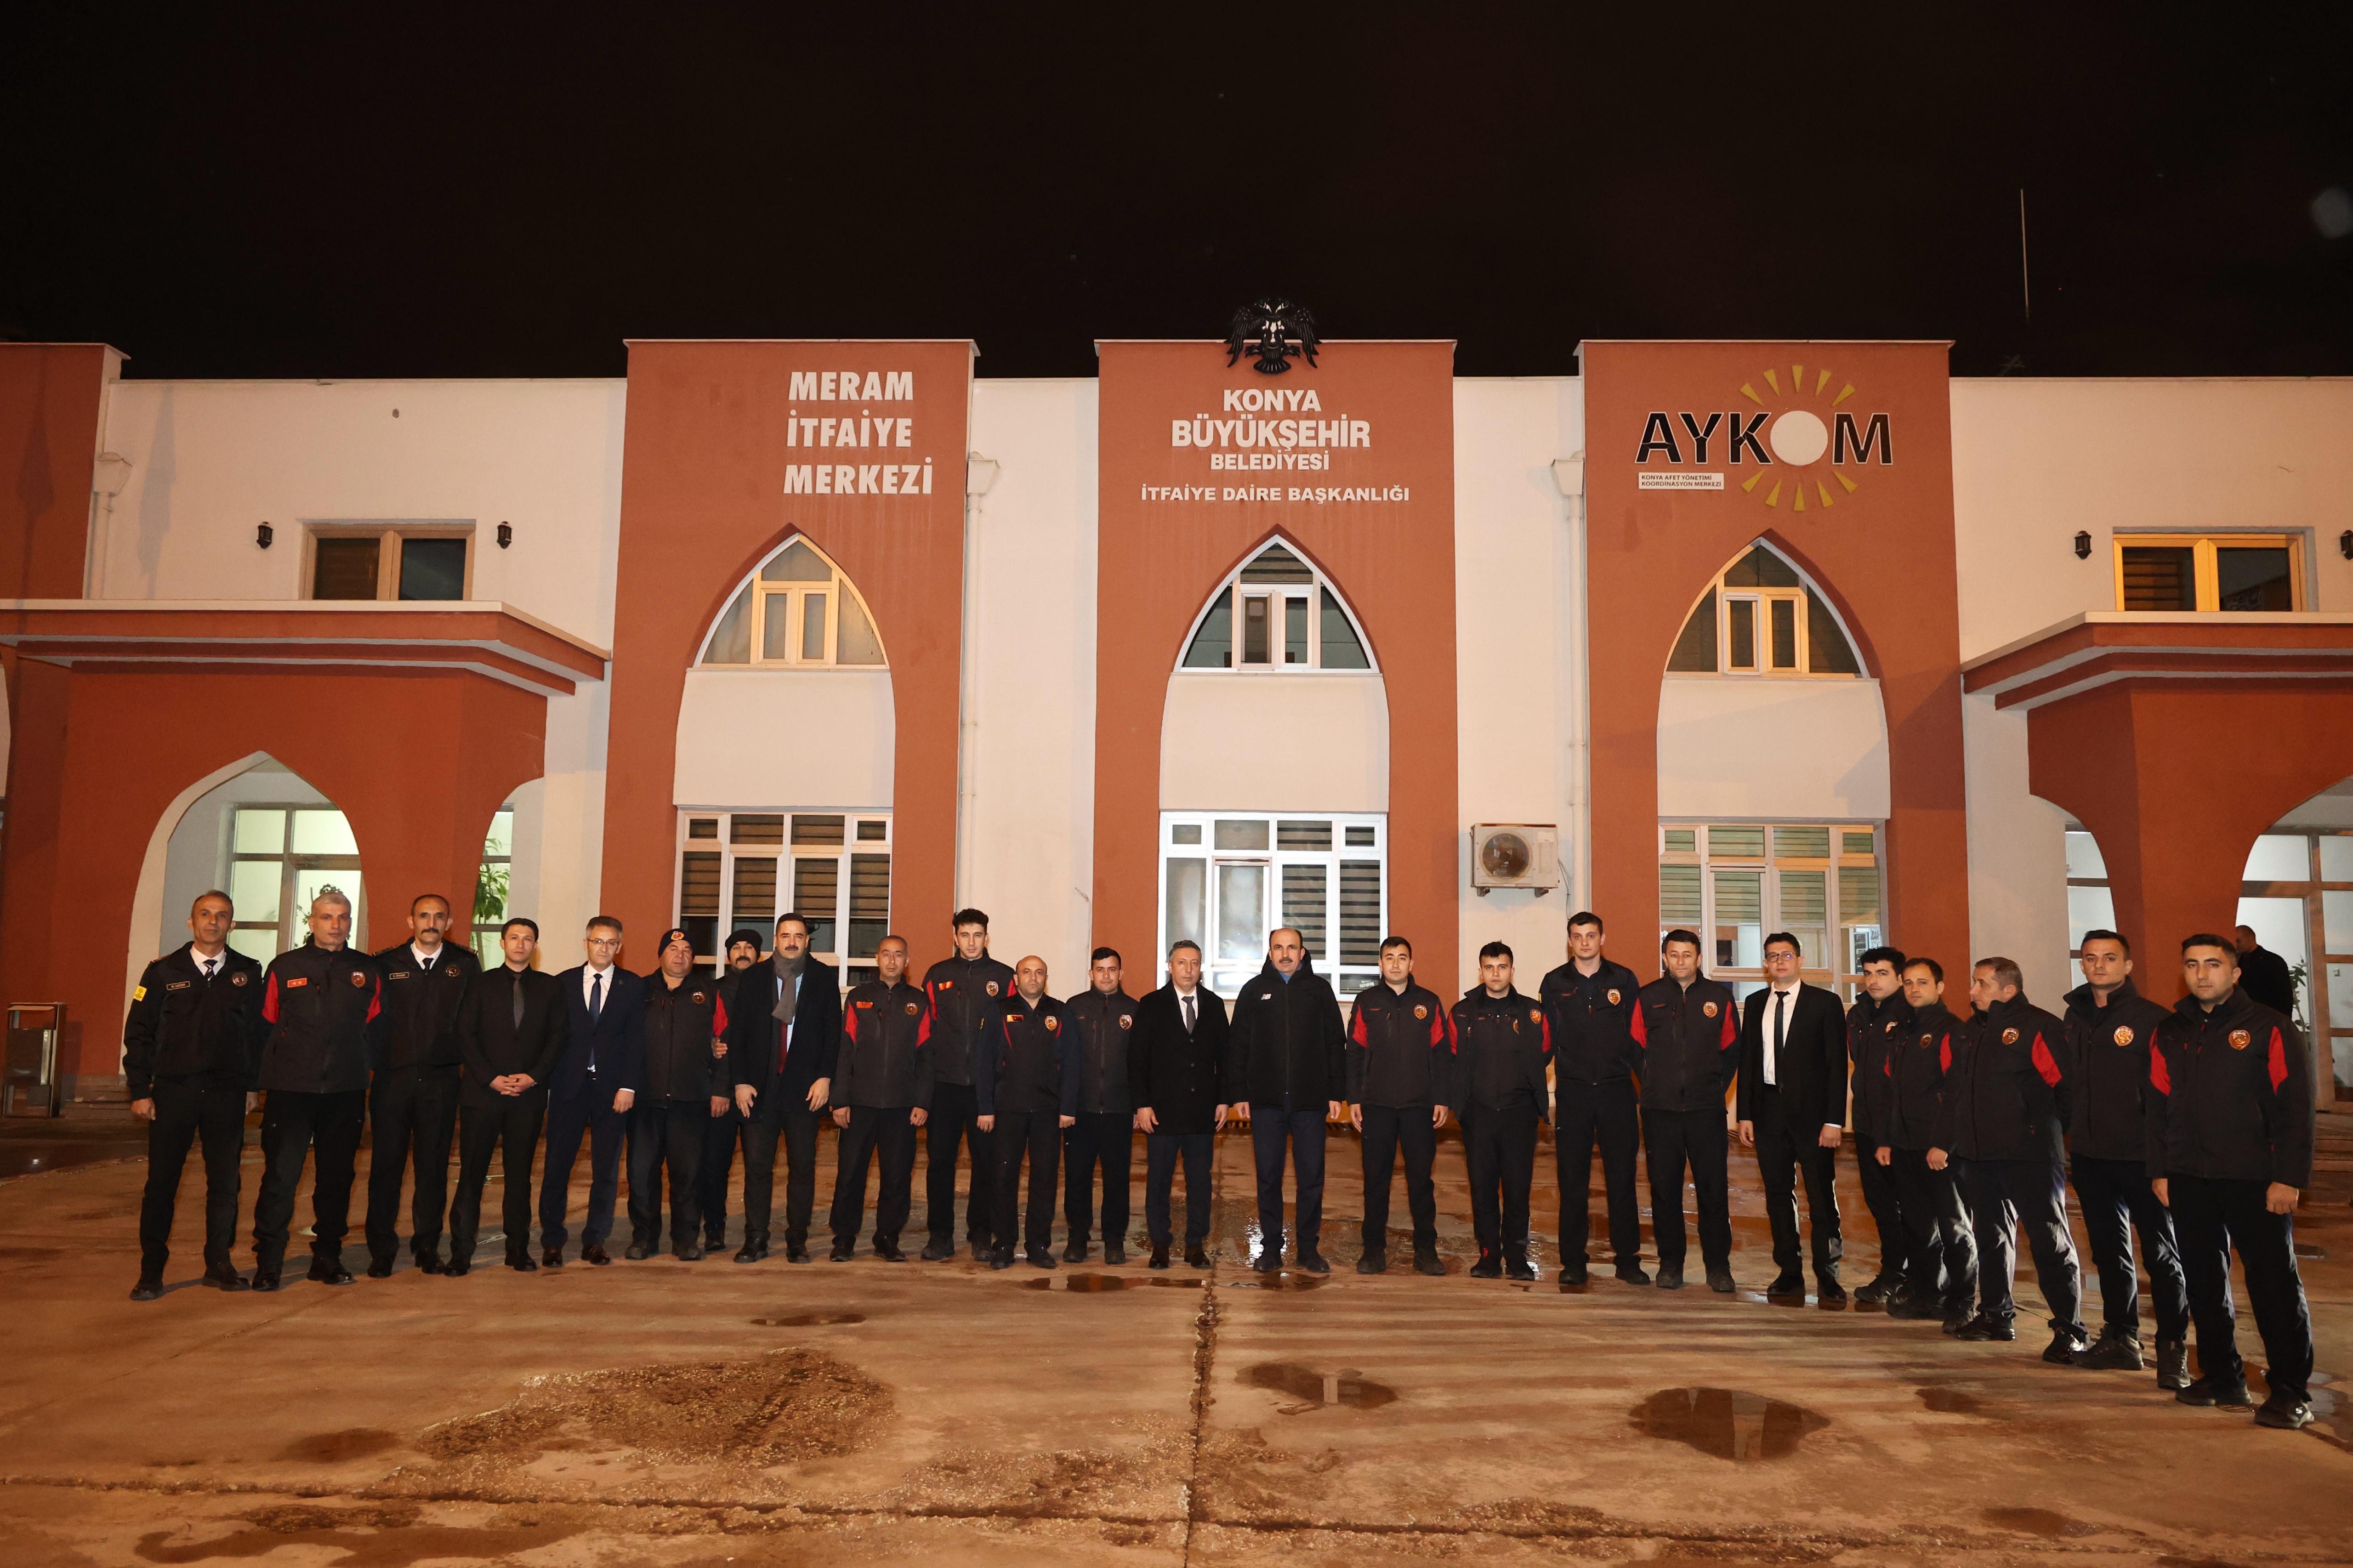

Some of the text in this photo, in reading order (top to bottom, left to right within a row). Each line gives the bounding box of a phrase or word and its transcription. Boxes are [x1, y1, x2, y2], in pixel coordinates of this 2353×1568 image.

[789, 371, 914, 401] MERAM
[1223, 389, 1322, 412] KONYA
[787, 409, 912, 447] İTFAİYE
[1172, 414, 1371, 451] BÜYÜKŞEHİR
[1211, 449, 1329, 470] BELEDİYESİ
[784, 457, 932, 494] MERKEZİ
[1142, 483, 1410, 504] İTFAİYE DAİRE BAŞKANLIĞI
